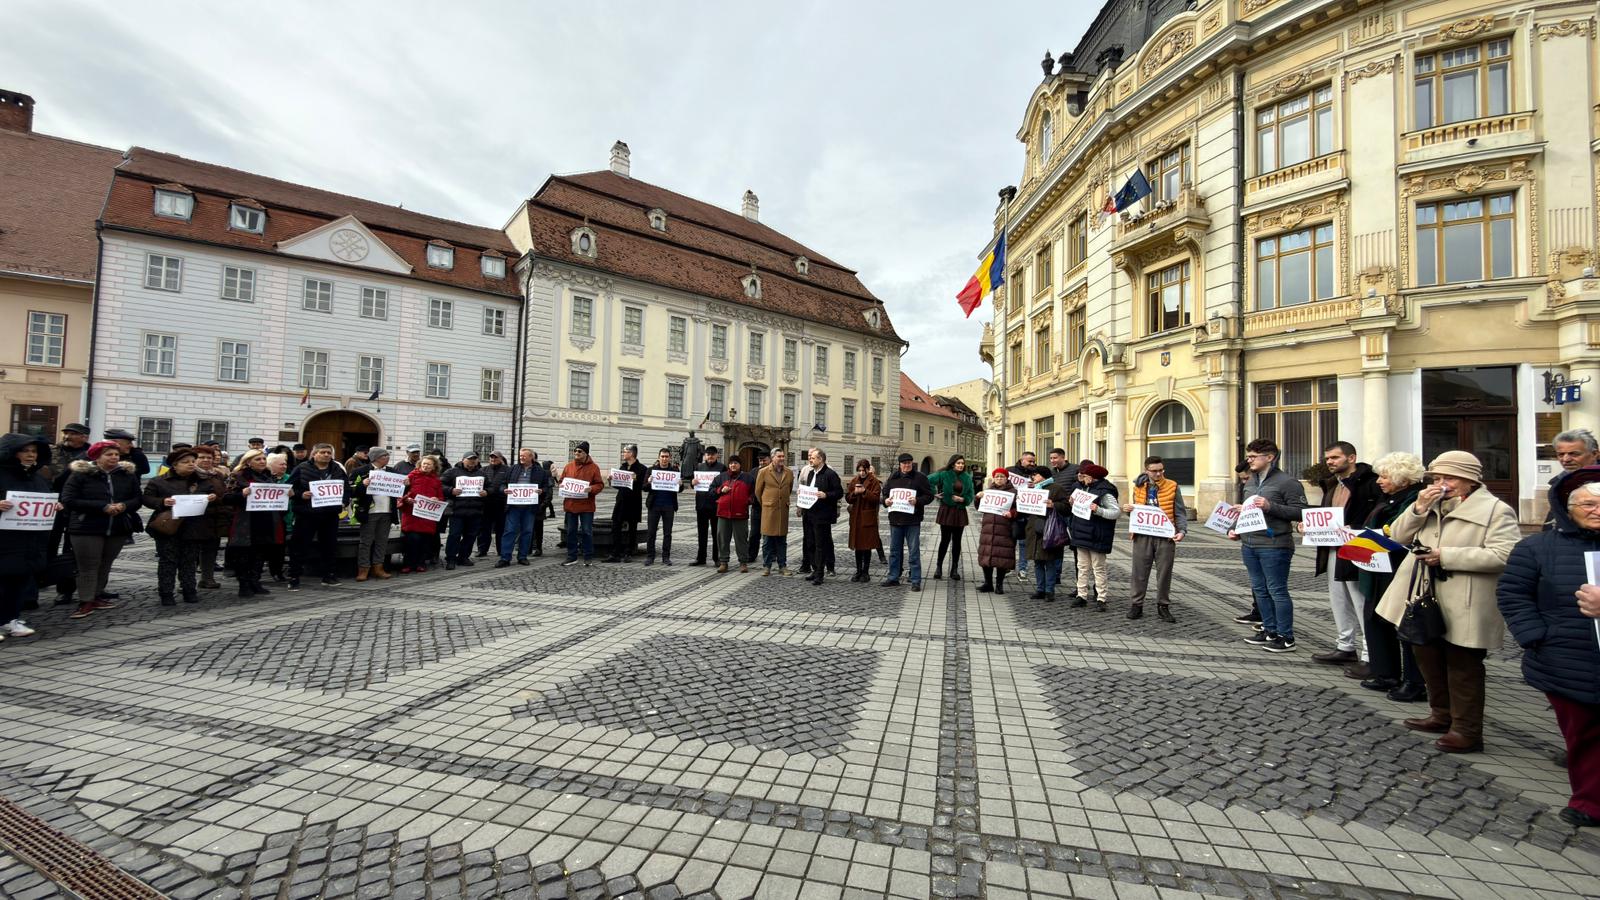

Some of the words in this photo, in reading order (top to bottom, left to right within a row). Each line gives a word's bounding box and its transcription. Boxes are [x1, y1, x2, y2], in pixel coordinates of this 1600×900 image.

[614, 472, 631, 481] STOP
[656, 472, 676, 481] STOP
[1009, 474, 1026, 486] TOP
[512, 488, 534, 498] STOP
[564, 482, 585, 492] STOP
[254, 488, 285, 500] STOP
[1020, 493, 1043, 505] STOP
[1074, 492, 1092, 504] STOP
[417, 499, 442, 511] STOP
[984, 494, 1008, 507] STOP
[1137, 511, 1168, 527] STOP
[1305, 511, 1333, 528] STOP
